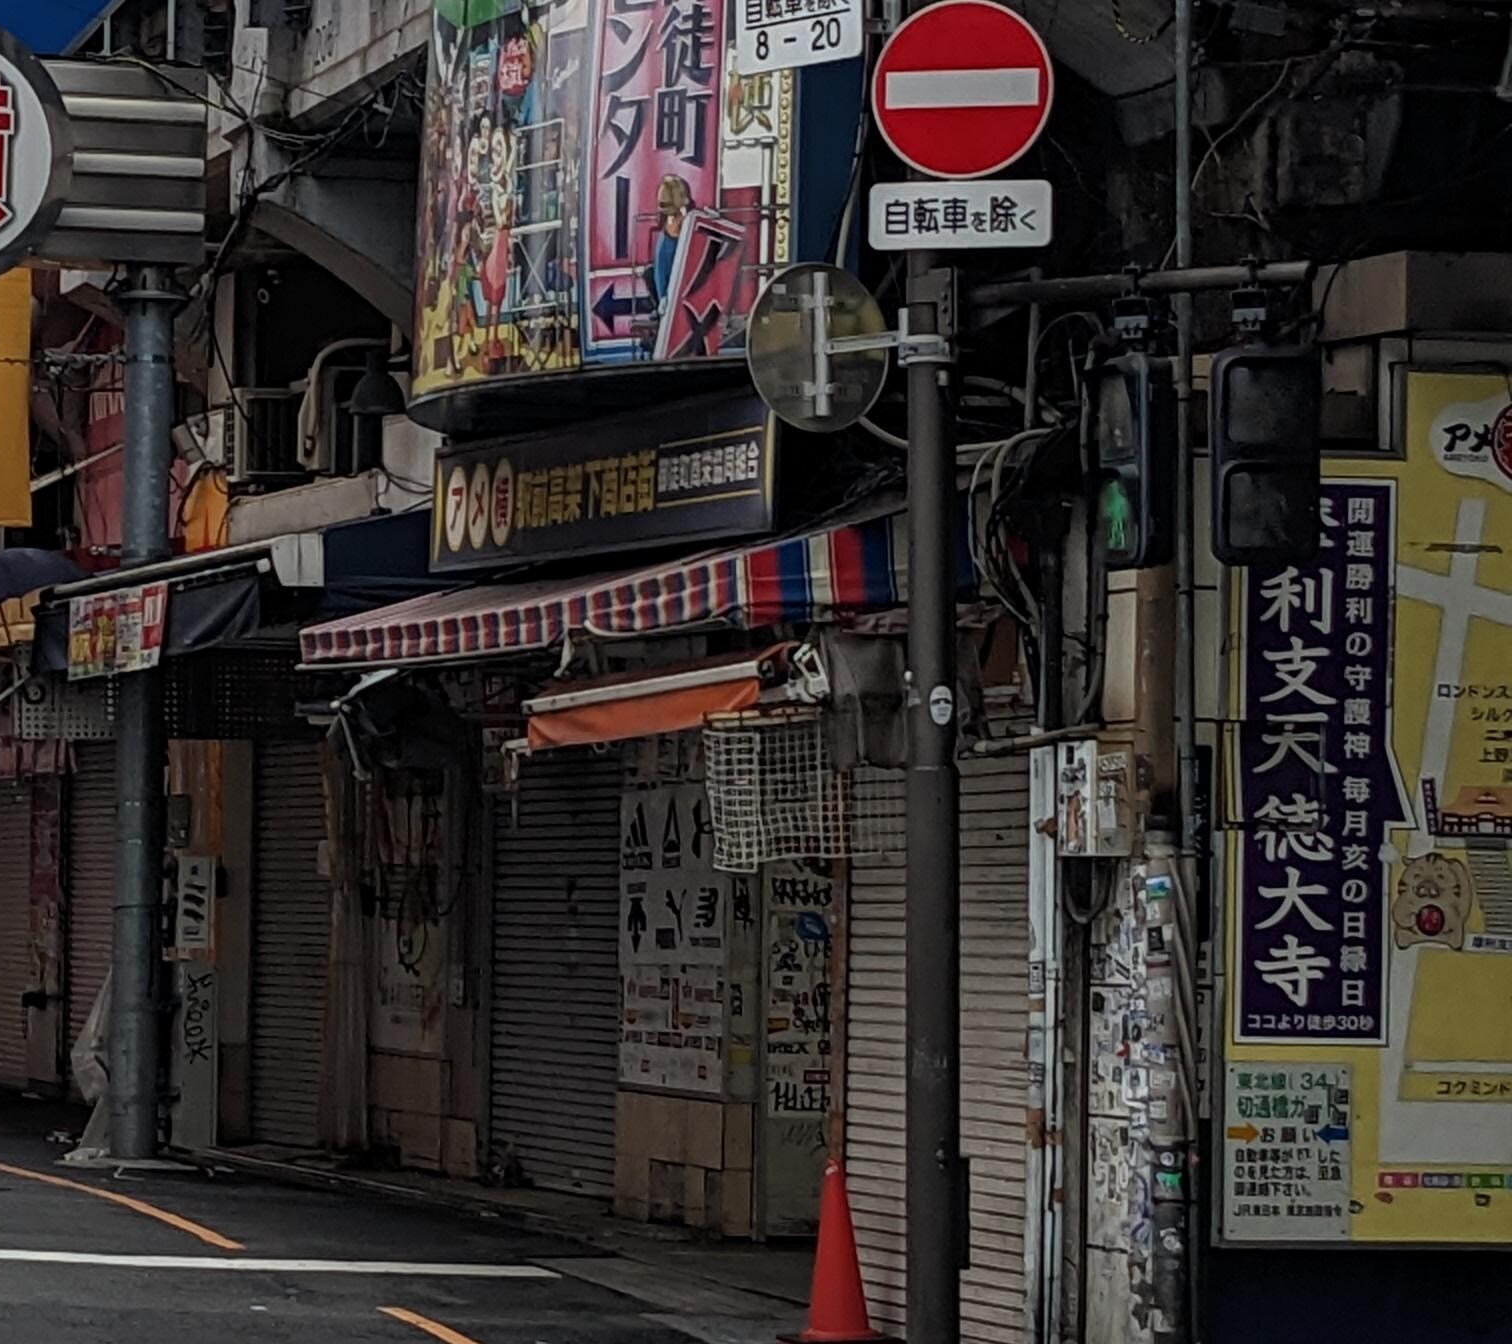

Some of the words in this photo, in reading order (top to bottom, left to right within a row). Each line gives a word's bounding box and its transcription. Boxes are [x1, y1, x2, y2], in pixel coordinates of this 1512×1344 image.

[885, 199, 1038, 235] 自転車を除く
[1251, 498, 1341, 1008] 利支天徳大寺
